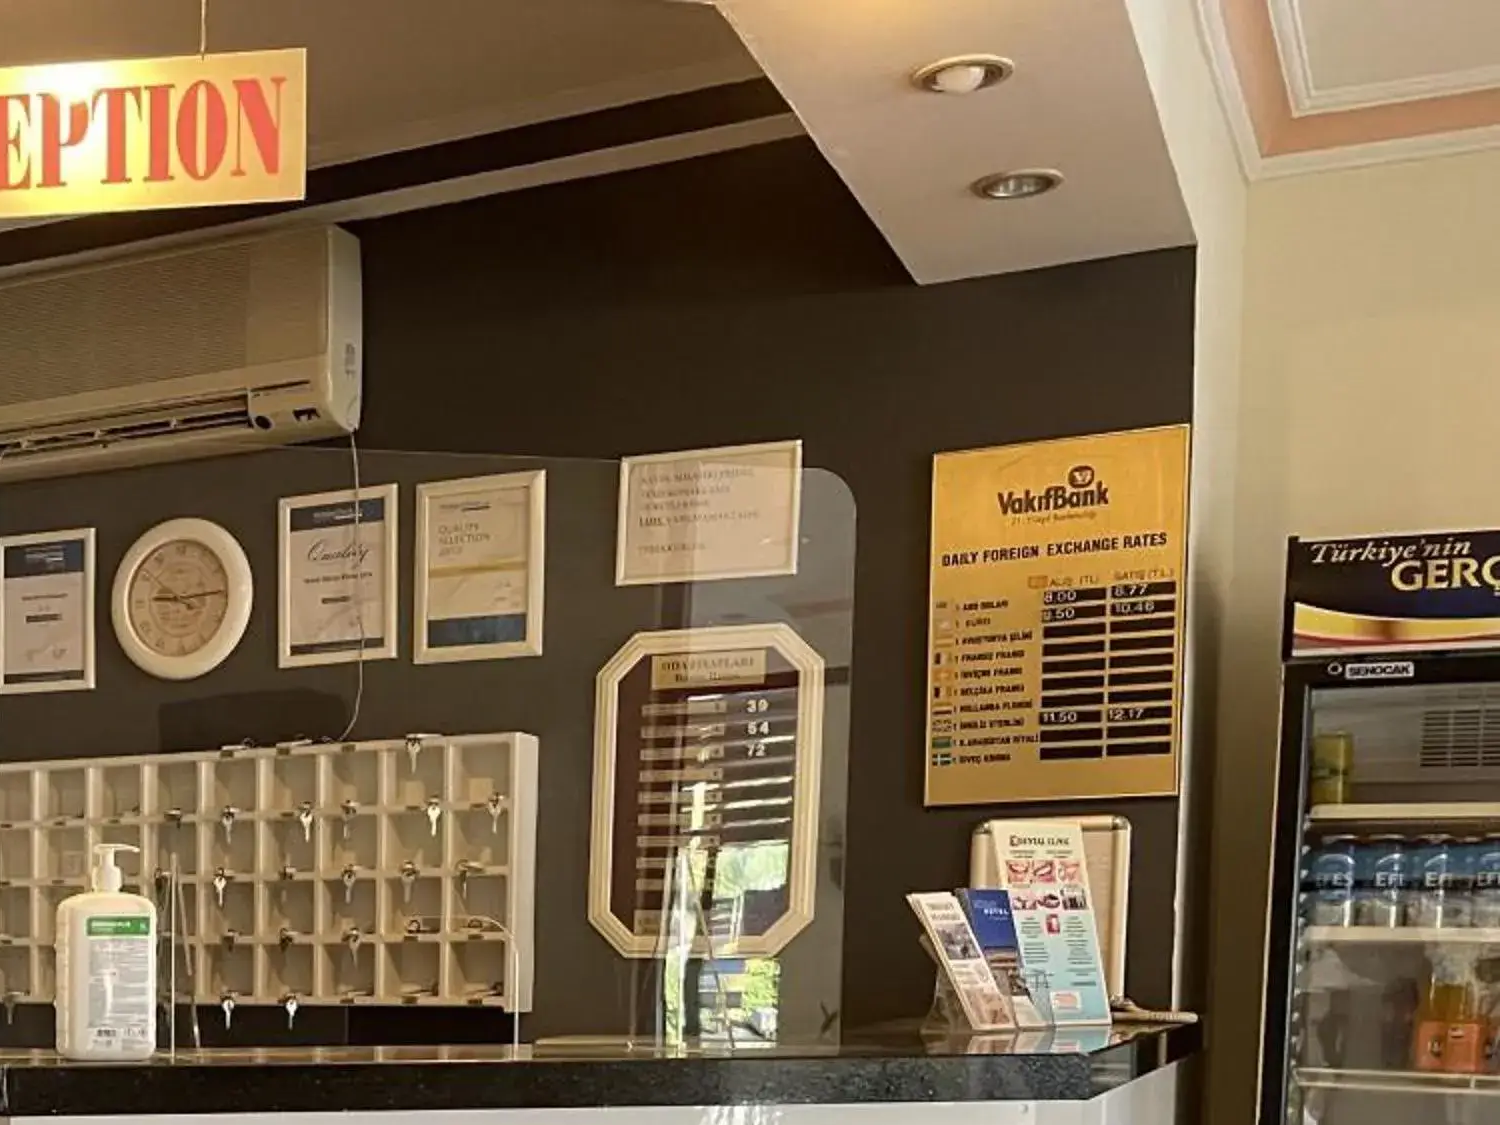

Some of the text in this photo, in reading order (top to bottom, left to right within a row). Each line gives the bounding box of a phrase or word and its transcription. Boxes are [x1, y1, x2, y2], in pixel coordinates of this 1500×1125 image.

[941, 531, 1168, 567] DAILY FOREIGN EXCHANGE RATES
[1311, 537, 1472, 567] Türkiye'nin
[748, 721, 769, 735] 54
